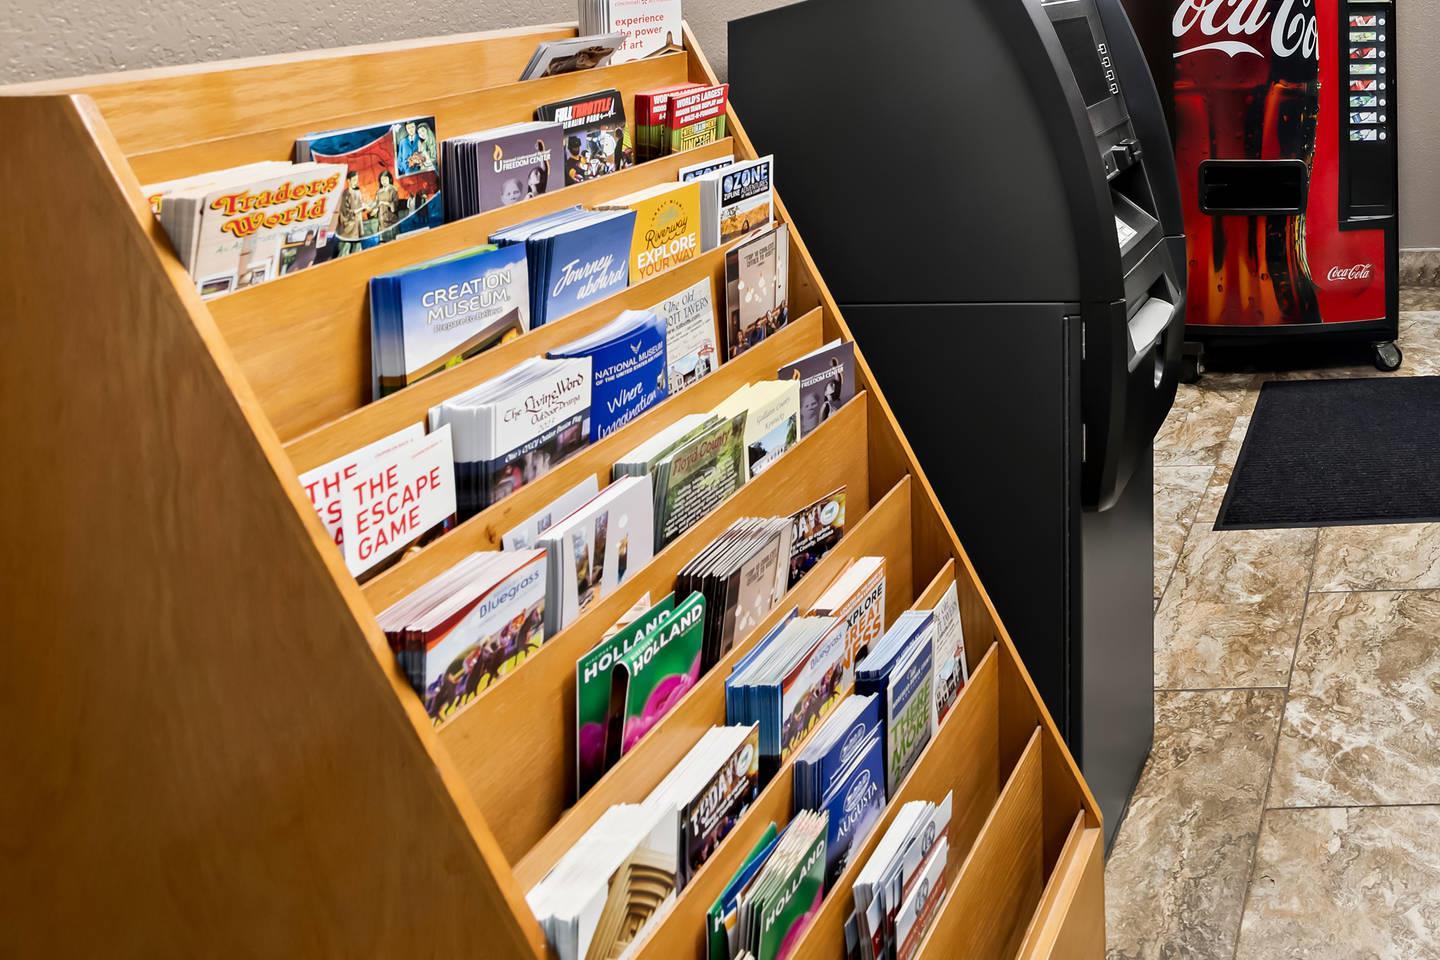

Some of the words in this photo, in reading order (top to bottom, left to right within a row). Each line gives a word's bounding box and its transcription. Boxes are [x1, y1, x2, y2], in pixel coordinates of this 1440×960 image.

[615, 14, 664, 27] experience
[635, 26, 662, 39] power
[630, 40, 643, 50] art
[701, 87, 724, 102] LARGEST
[503, 158, 529, 171] FREEDOM
[723, 163, 769, 193] OZONE
[210, 172, 340, 216] Traders
[220, 197, 327, 238] World
[645, 216, 688, 250] Riverway
[637, 232, 697, 269] EXPLORE
[639, 257, 670, 279] YOUR
[673, 246, 696, 265] WAY
[422, 271, 511, 308] CREATION
[553, 253, 613, 297] Journey
[576, 259, 626, 300] aboard
[1327, 264, 1372, 281] Coca-Cola
[427, 288, 508, 325] MUSEUM
[682, 289, 694, 306] Old
[684, 296, 708, 319] TAVERN
[595, 357, 638, 380] NATIONAL
[639, 341, 664, 362] MUSEUM
[604, 375, 615, 383] THE
[616, 367, 632, 378] UNITED
[557, 373, 584, 395] Word
[607, 382, 643, 413] Where
[801, 373, 826, 389] FREEDOM
[305, 464, 358, 505] THE
[353, 464, 399, 505] THE
[356, 466, 441, 535] ESCAPE
[358, 505, 421, 561] GAME
[479, 570, 540, 619] Bluegrass
[846, 582, 883, 631] XPLORE
[584, 610, 671, 684] HOLLAND
[633, 604, 703, 676] HOLLAND
[837, 782, 877, 842] AUGUSTA
[766, 840, 825, 932] HOLLAND
